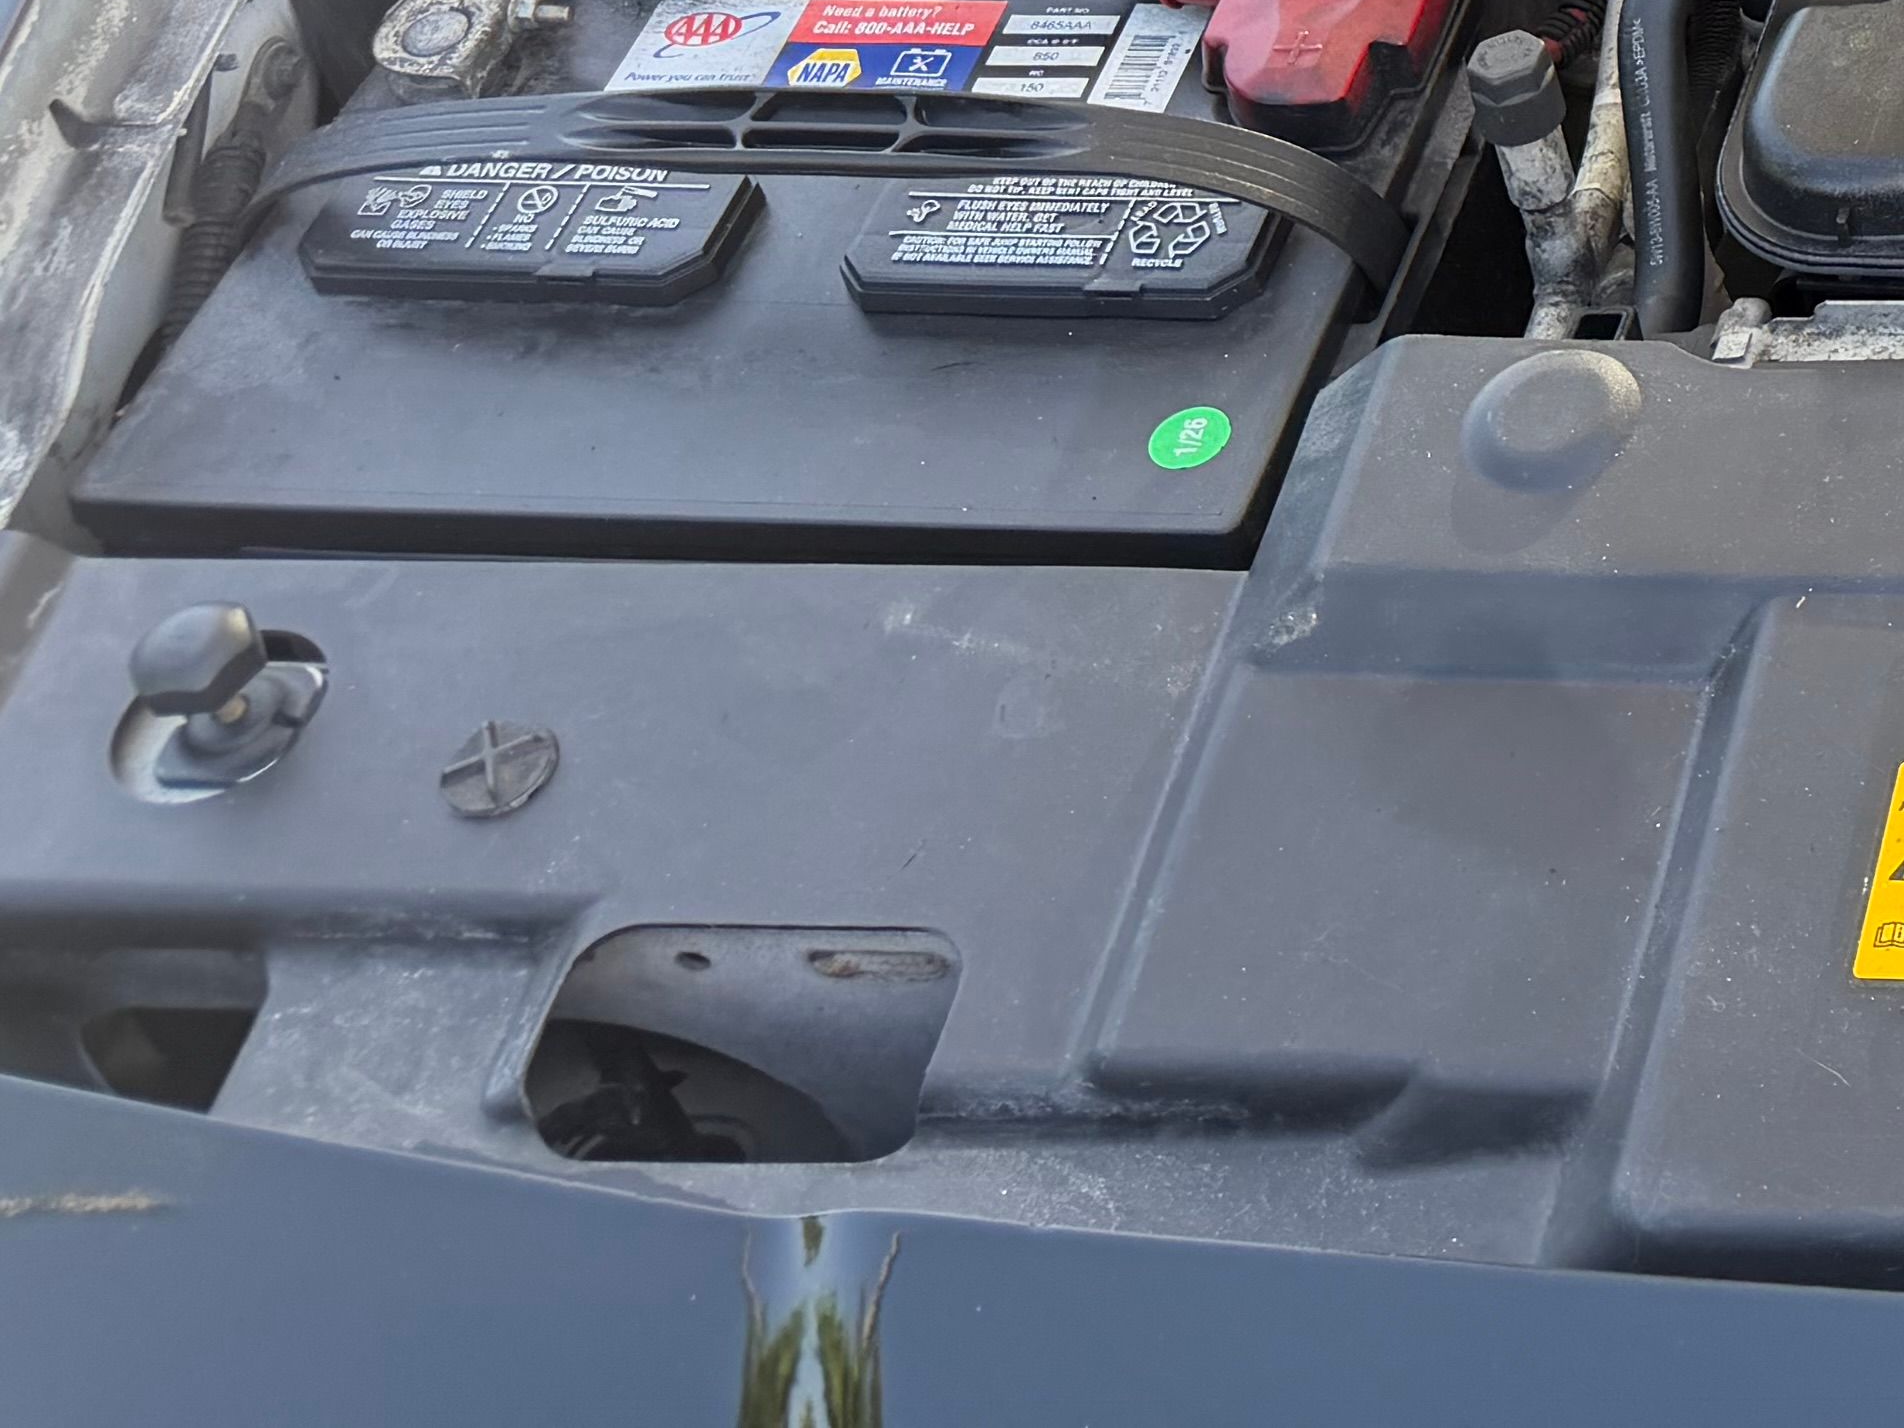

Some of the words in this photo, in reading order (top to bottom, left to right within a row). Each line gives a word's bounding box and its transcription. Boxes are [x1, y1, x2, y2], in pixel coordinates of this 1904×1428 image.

[823, 5, 861, 17] Need
[865, 8, 875, 17] a
[880, 5, 941, 20] battery?
[669, 14, 740, 44] AAA
[812, 21, 851, 34] Call:
[625, 71, 665, 82] Power
[667, 74, 690, 83] you
[693, 73, 715, 81] can
[800, 63, 851, 83] NAPA
[876, 77, 947, 87] MAINTENANCE
[446, 163, 552, 179] DANGER
[574, 165, 669, 181] POISON
[1023, 178, 1040, 186] OUT
[440, 190, 488, 199] SHIELD
[433, 200, 469, 209] EYES
[957, 200, 995, 211] FLUSH
[997, 201, 1028, 211] EYES
[1029, 202, 1110, 213] IMMEDIATELY
[397, 210, 469, 220] EXPLOSIVE
[513, 214, 534, 223] NO
[953, 211, 984, 221] WITH
[1033, 213, 1059, 223] GET
[390, 220, 436, 229] GASES
[583, 216, 647, 227] SULFURIC
[648, 218, 680, 229] ACID
[946, 221, 998, 232] MEDICAL
[1000, 222, 1031, 232] HELP
[1033, 223, 1065, 233] FAST
[1131, 258, 1185, 268] RECYCLE
[1173, 417, 1208, 457] 1/26
